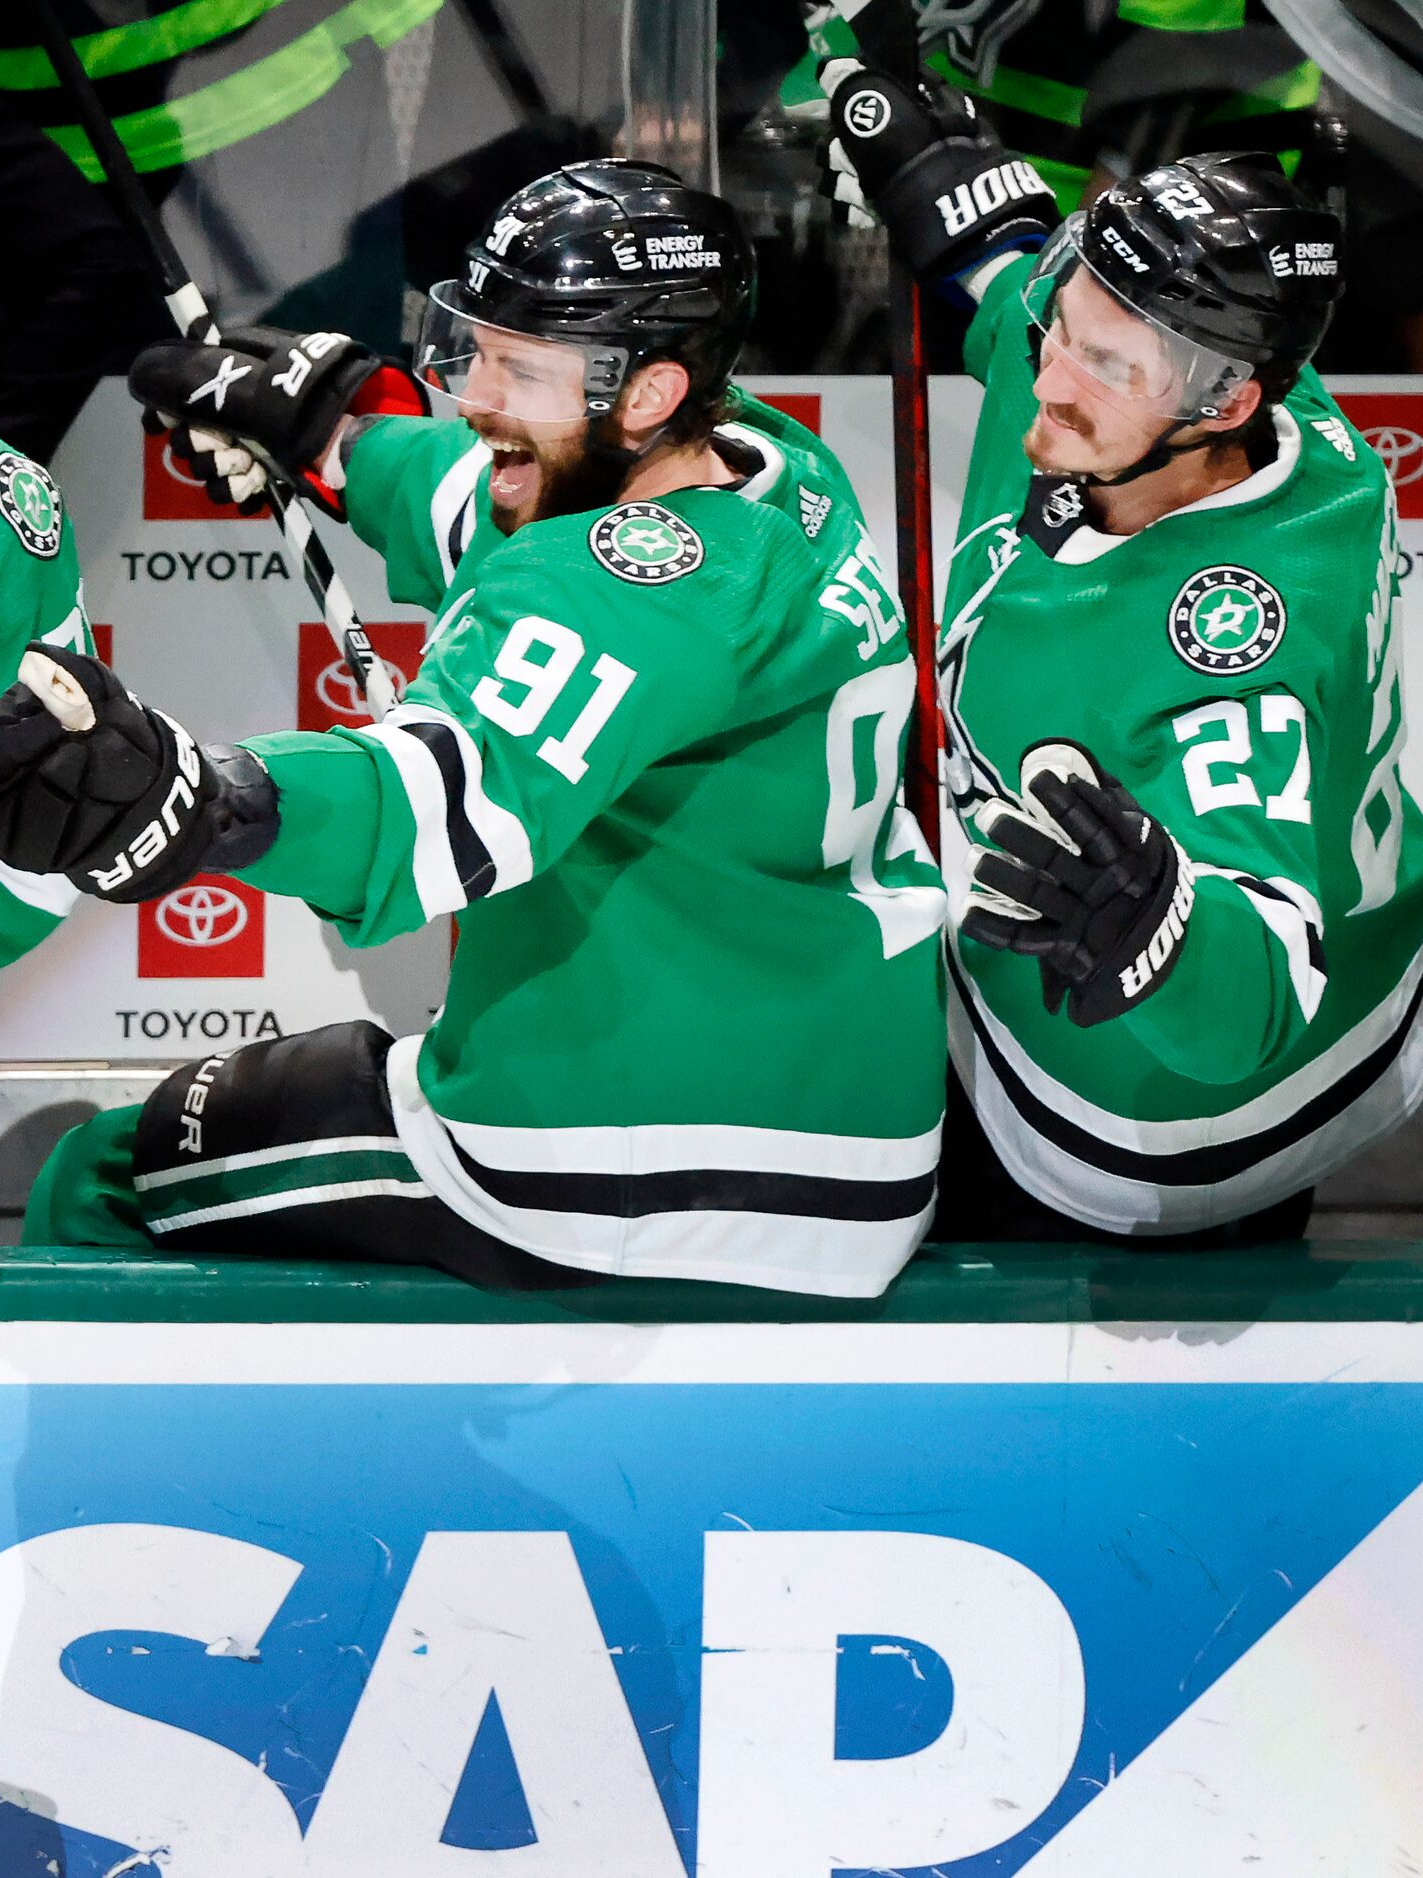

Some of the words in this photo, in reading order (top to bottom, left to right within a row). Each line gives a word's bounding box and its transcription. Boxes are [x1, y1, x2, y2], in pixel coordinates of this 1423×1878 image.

[645, 235, 705, 254] ENERGY
[647, 252, 722, 270] TRANSFER
[1102, 226, 1150, 273] CCM
[607, 506, 698, 555] DALLAS
[121, 552, 290, 580] TOYOTA
[597, 539, 682, 577] STARS
[1176, 571, 1274, 621] DALLAS
[1187, 628, 1276, 666] STARS
[470, 615, 638, 785] 91
[1172, 694, 1313, 825] 27
[116, 1010, 283, 1039] TOYOTA
